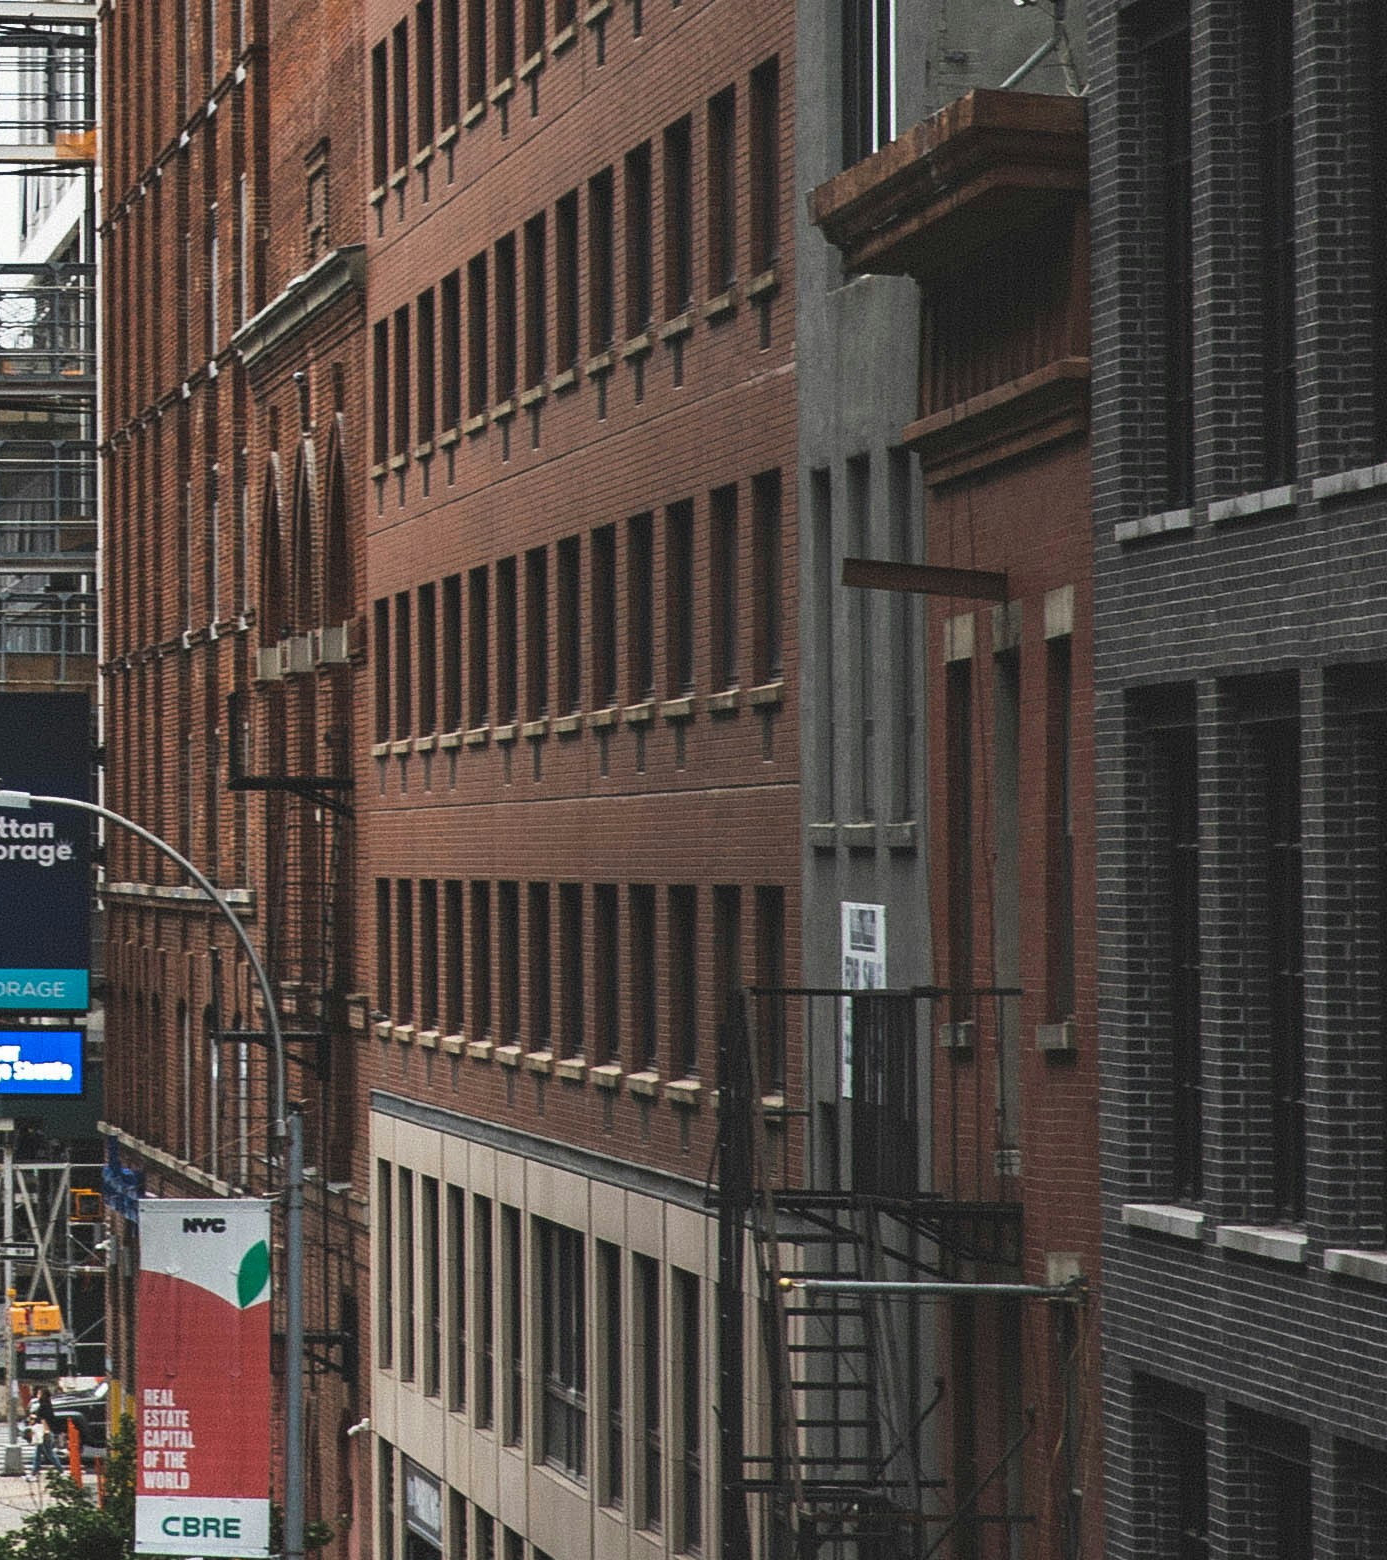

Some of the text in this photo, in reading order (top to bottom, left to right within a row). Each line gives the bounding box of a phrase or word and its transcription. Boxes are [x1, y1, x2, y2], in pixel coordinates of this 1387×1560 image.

[182, 1218, 226, 1233] NYC
[143, 1389, 175, 1407] REAL
[143, 1410, 190, 1428] ESTATE
[143, 1430, 195, 1448] CAPITAL
[143, 1451, 187, 1469] OF THE
[143, 1471, 190, 1489] WORLD
[161, 1516, 241, 1539] CBRE
